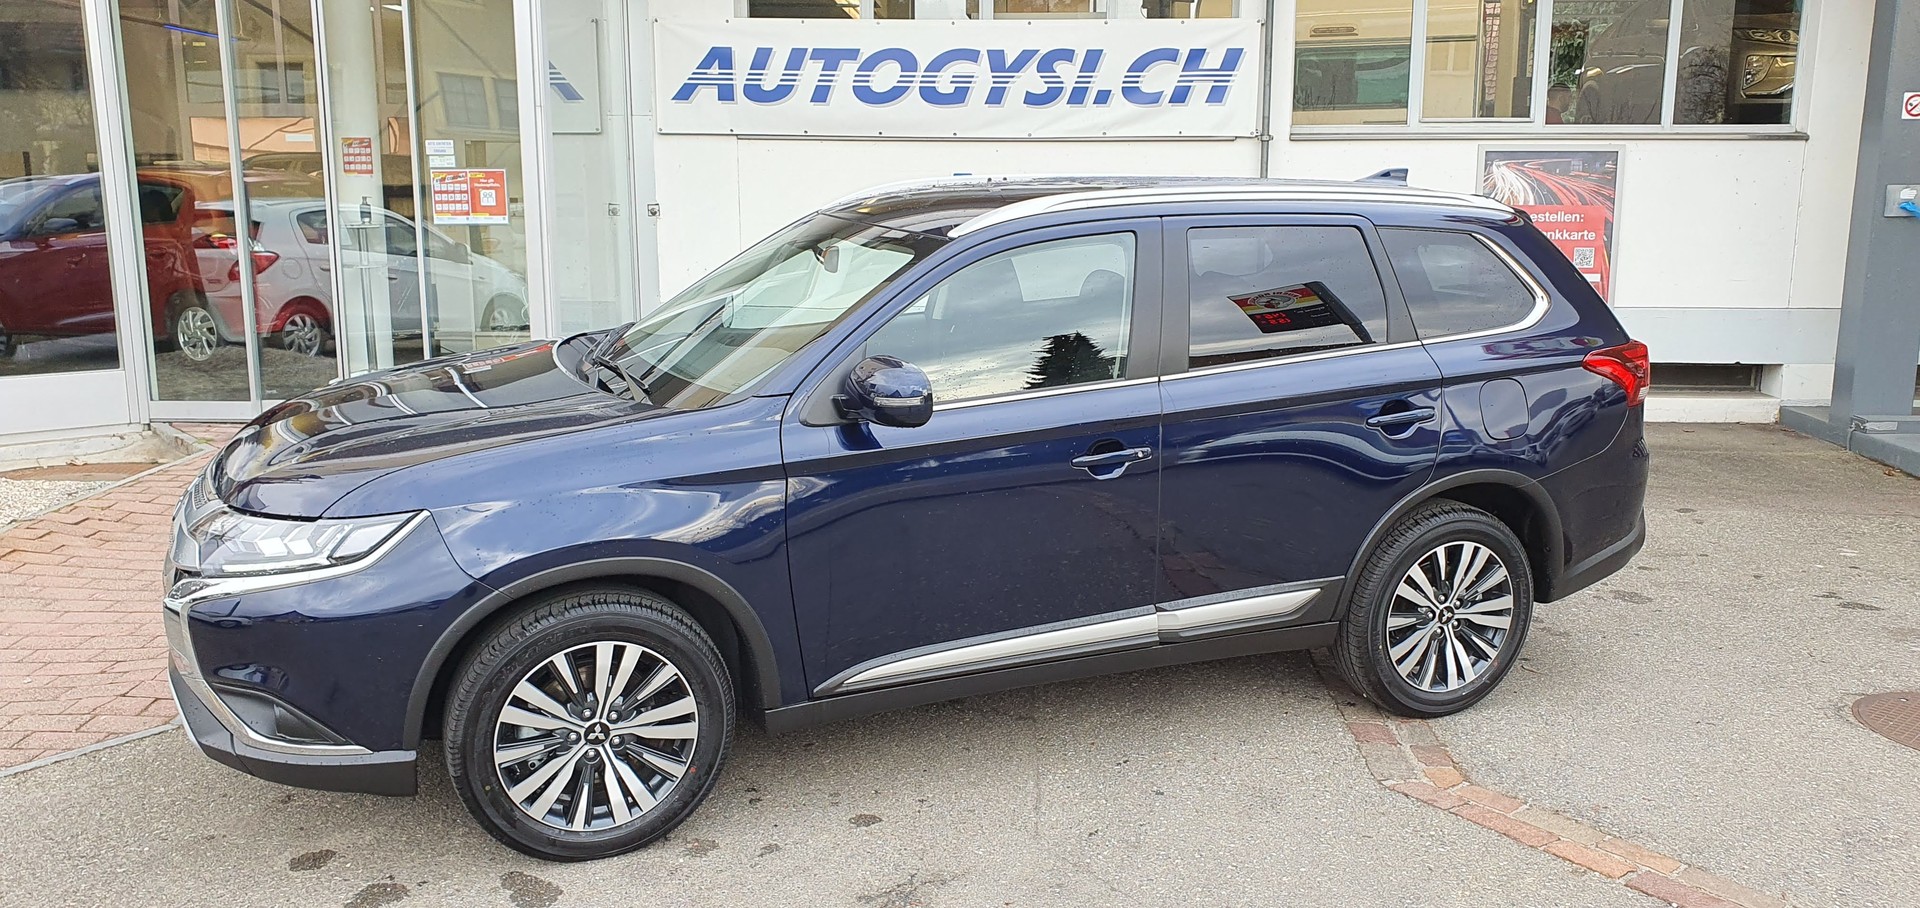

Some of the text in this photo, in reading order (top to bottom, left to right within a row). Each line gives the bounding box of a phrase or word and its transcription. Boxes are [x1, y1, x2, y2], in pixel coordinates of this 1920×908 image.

[671, 46, 1245, 106] AUTOGYSI.CH
[1529, 211, 1585, 223] estellen:
[1541, 229, 1596, 240] nkkarte
